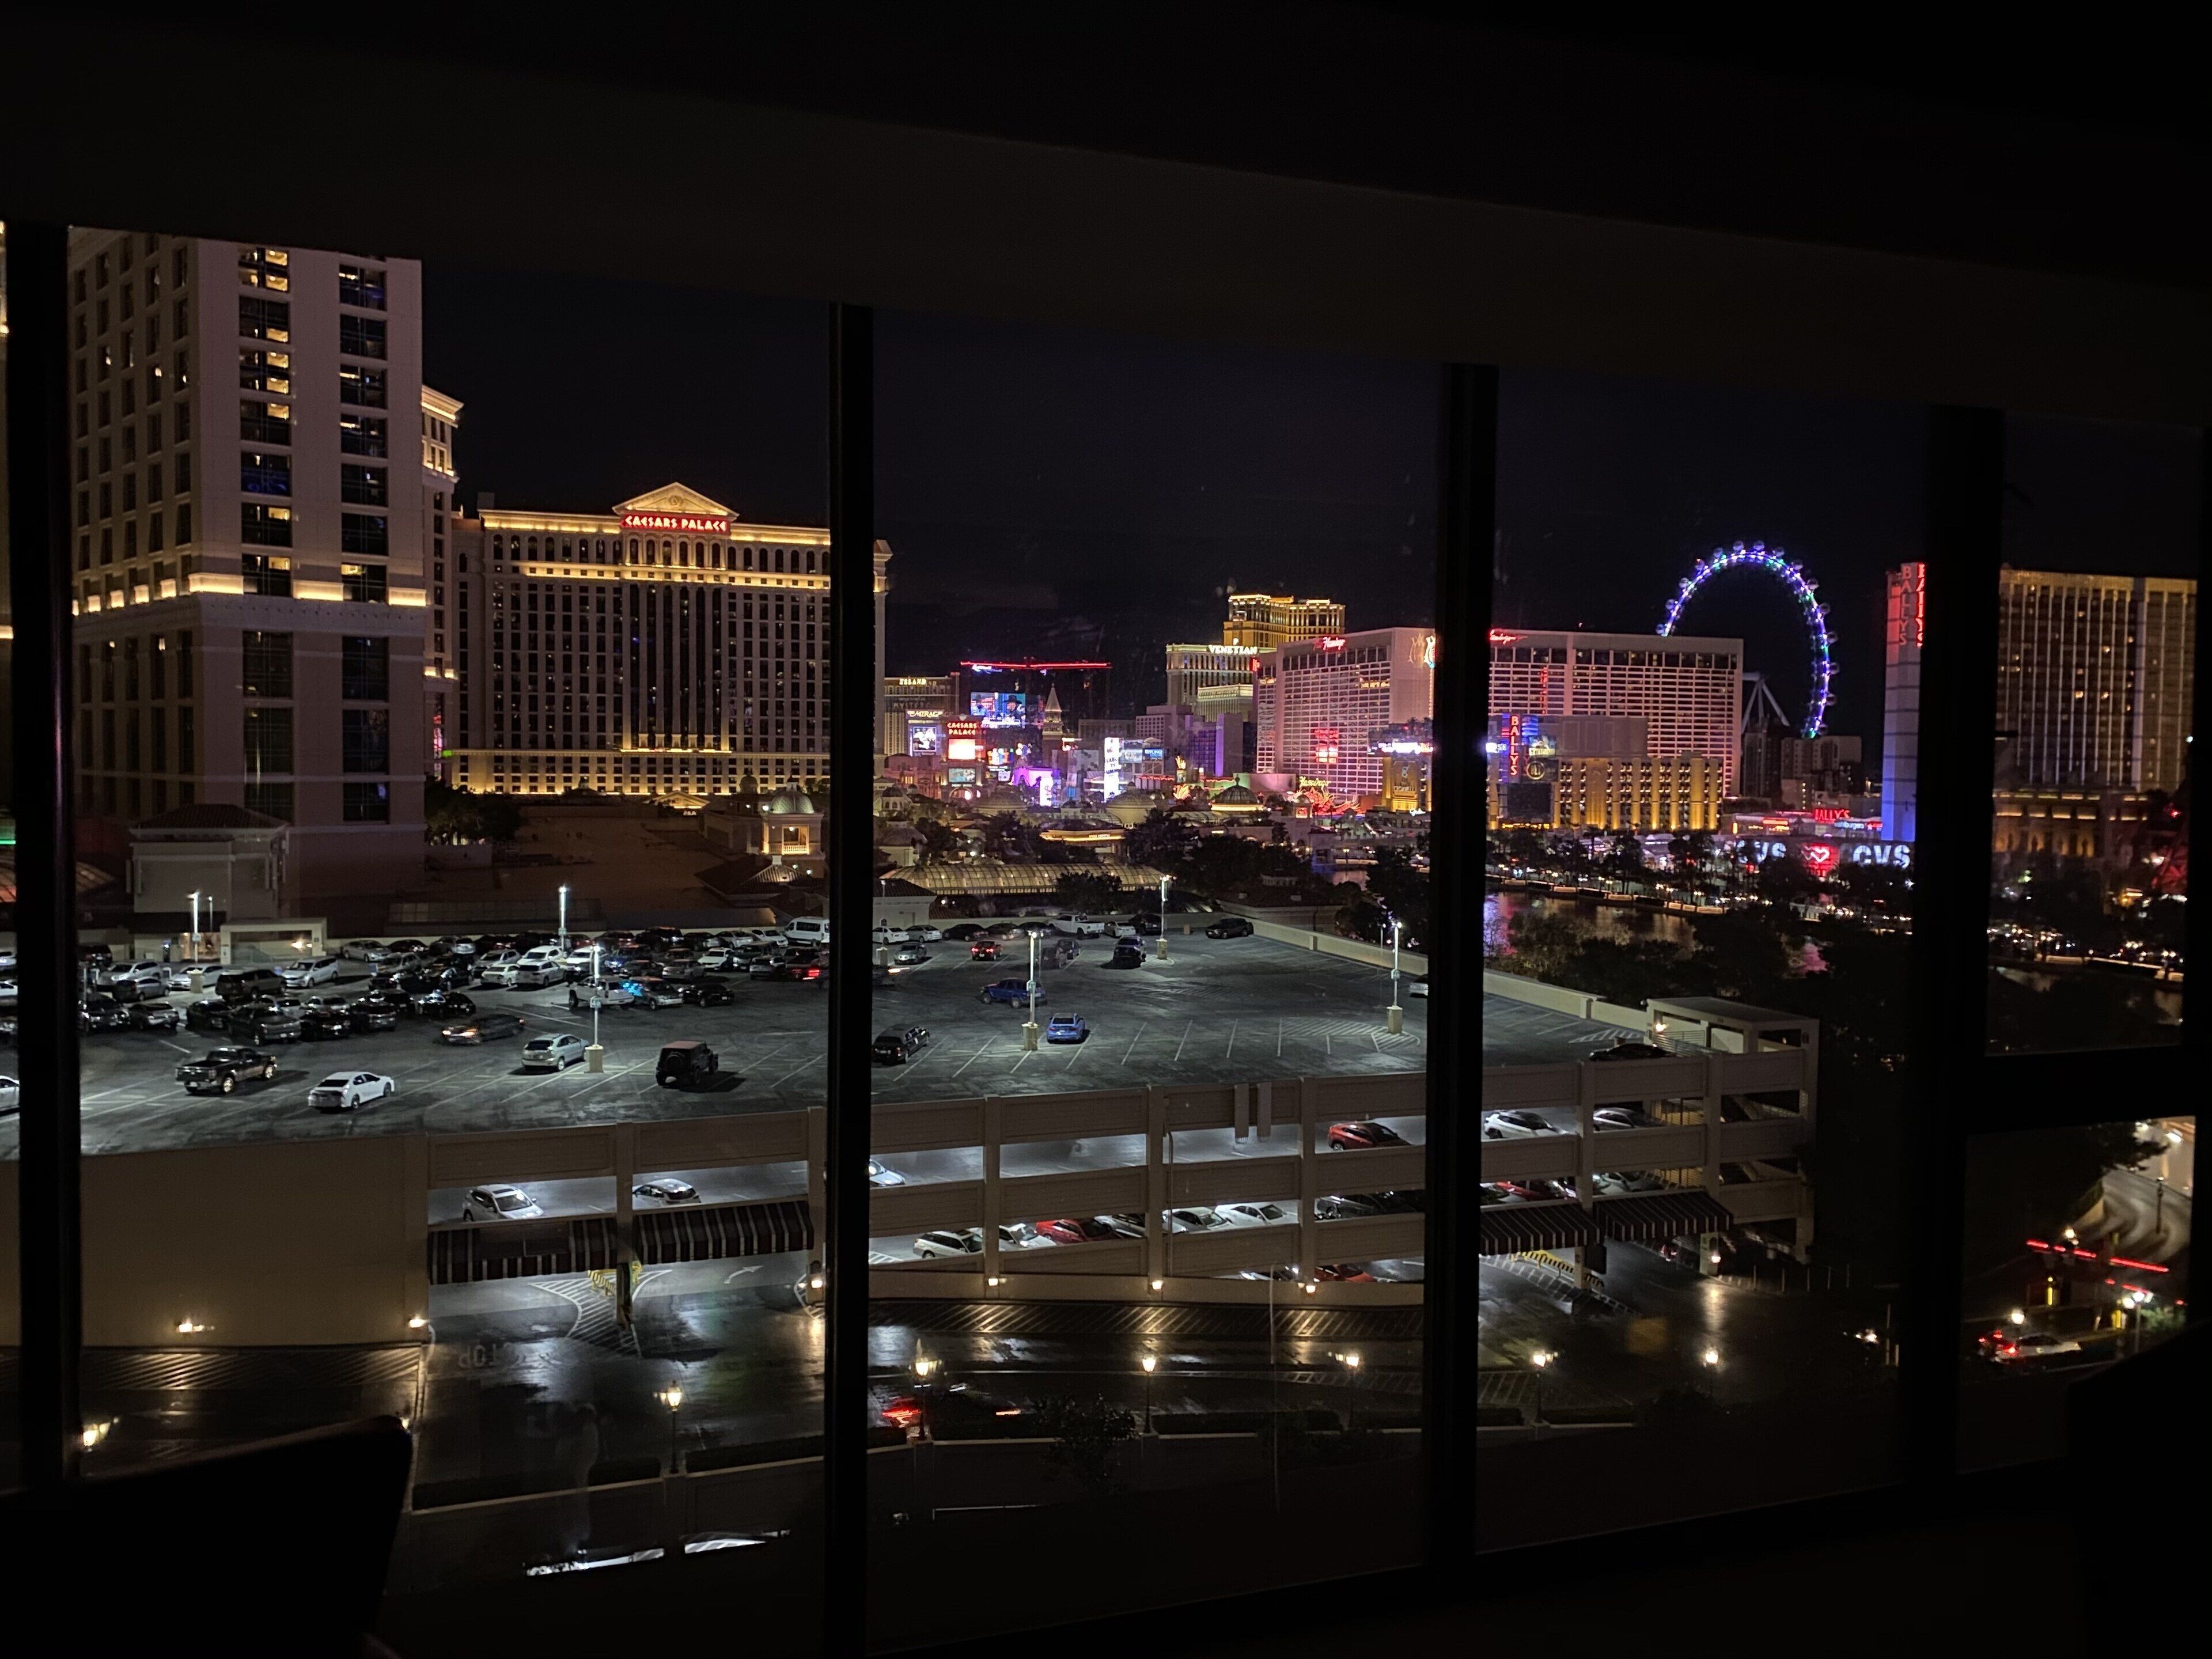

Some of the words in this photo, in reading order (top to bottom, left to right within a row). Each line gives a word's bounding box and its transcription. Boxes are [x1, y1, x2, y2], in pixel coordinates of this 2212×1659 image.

[625, 515, 677, 529] CAESARS
[681, 518, 726, 532] PALACE
[1209, 645, 1258, 654] VENETIAN
[1510, 715, 1520, 775] BALLYS
[1299, 776, 1331, 787] Flamingo
[1853, 844, 1910, 869] CVS
